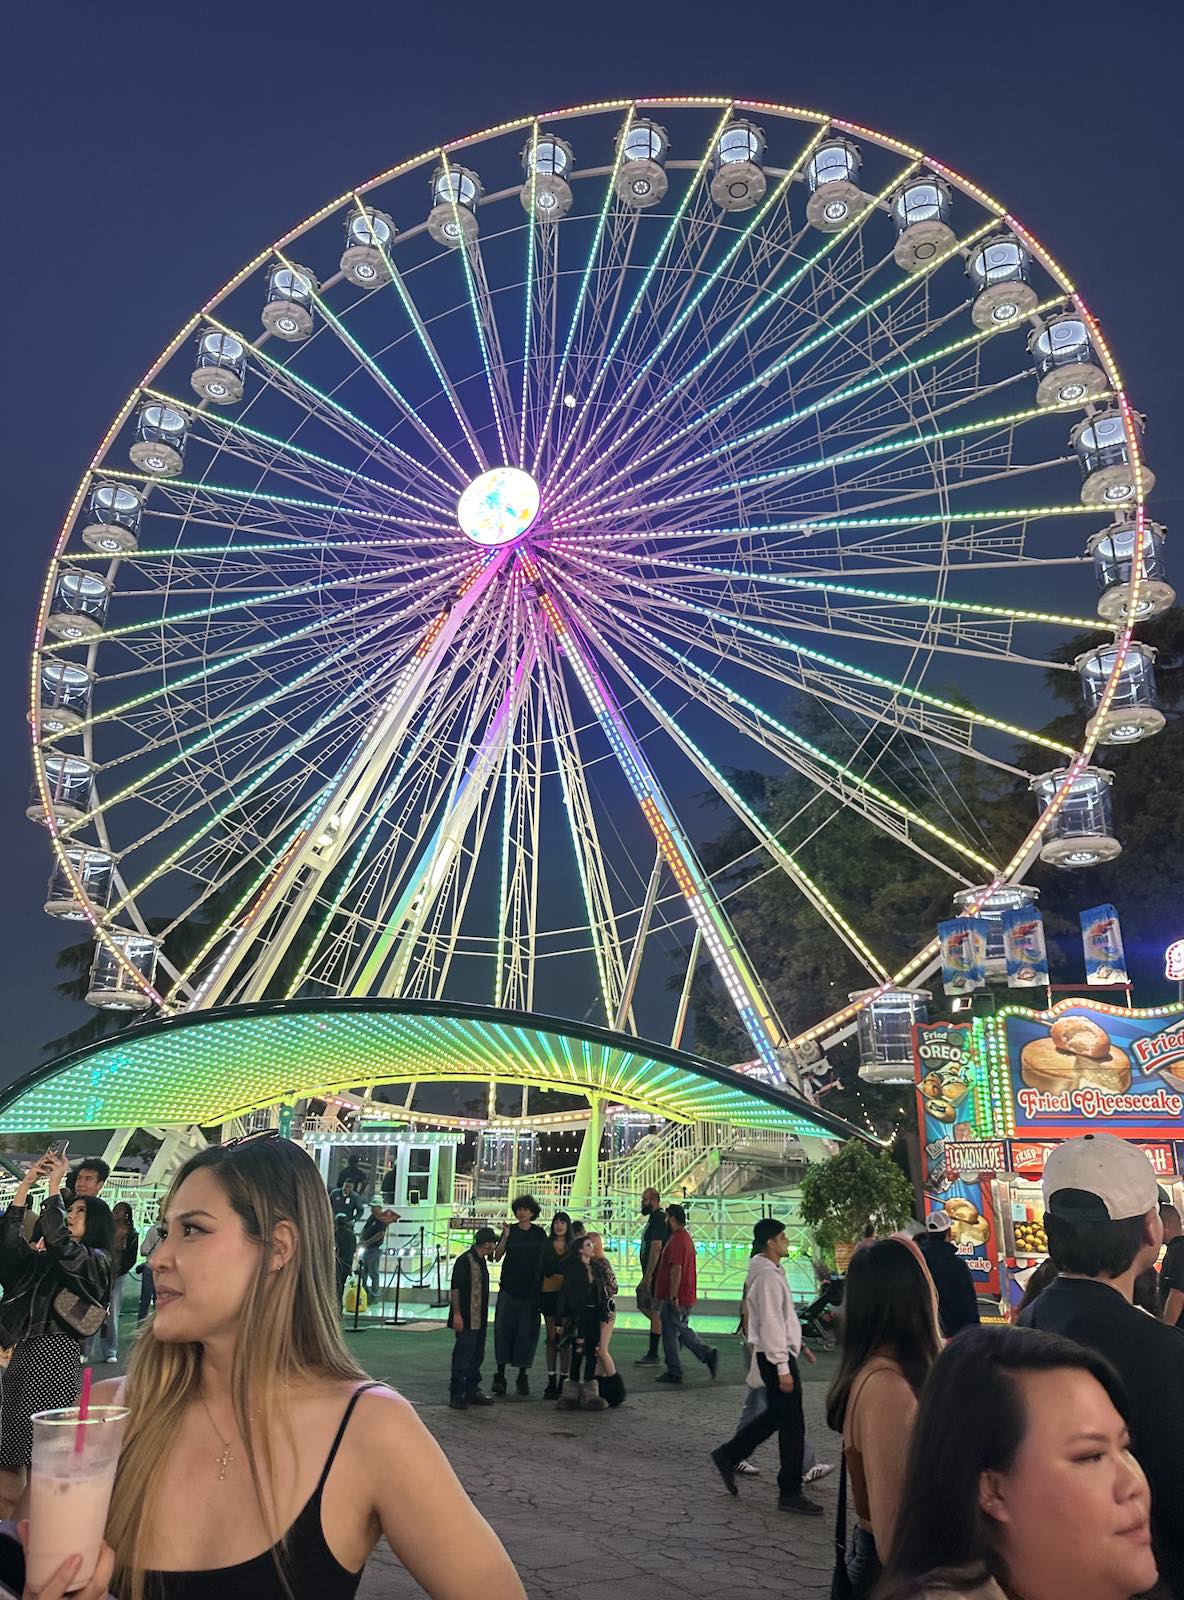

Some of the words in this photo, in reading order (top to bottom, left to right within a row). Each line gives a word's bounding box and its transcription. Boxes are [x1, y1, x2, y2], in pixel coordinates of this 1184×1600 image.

[923, 1031, 948, 1041] Fried
[1135, 1030, 1184, 1061] Fried
[919, 1045, 971, 1065] OREOS
[1019, 1090, 1070, 1117] Fried
[1073, 1088, 1182, 1116] Cheesecake
[949, 1147, 1000, 1169] LEMONADE
[1016, 1148, 1037, 1163] FRIED
